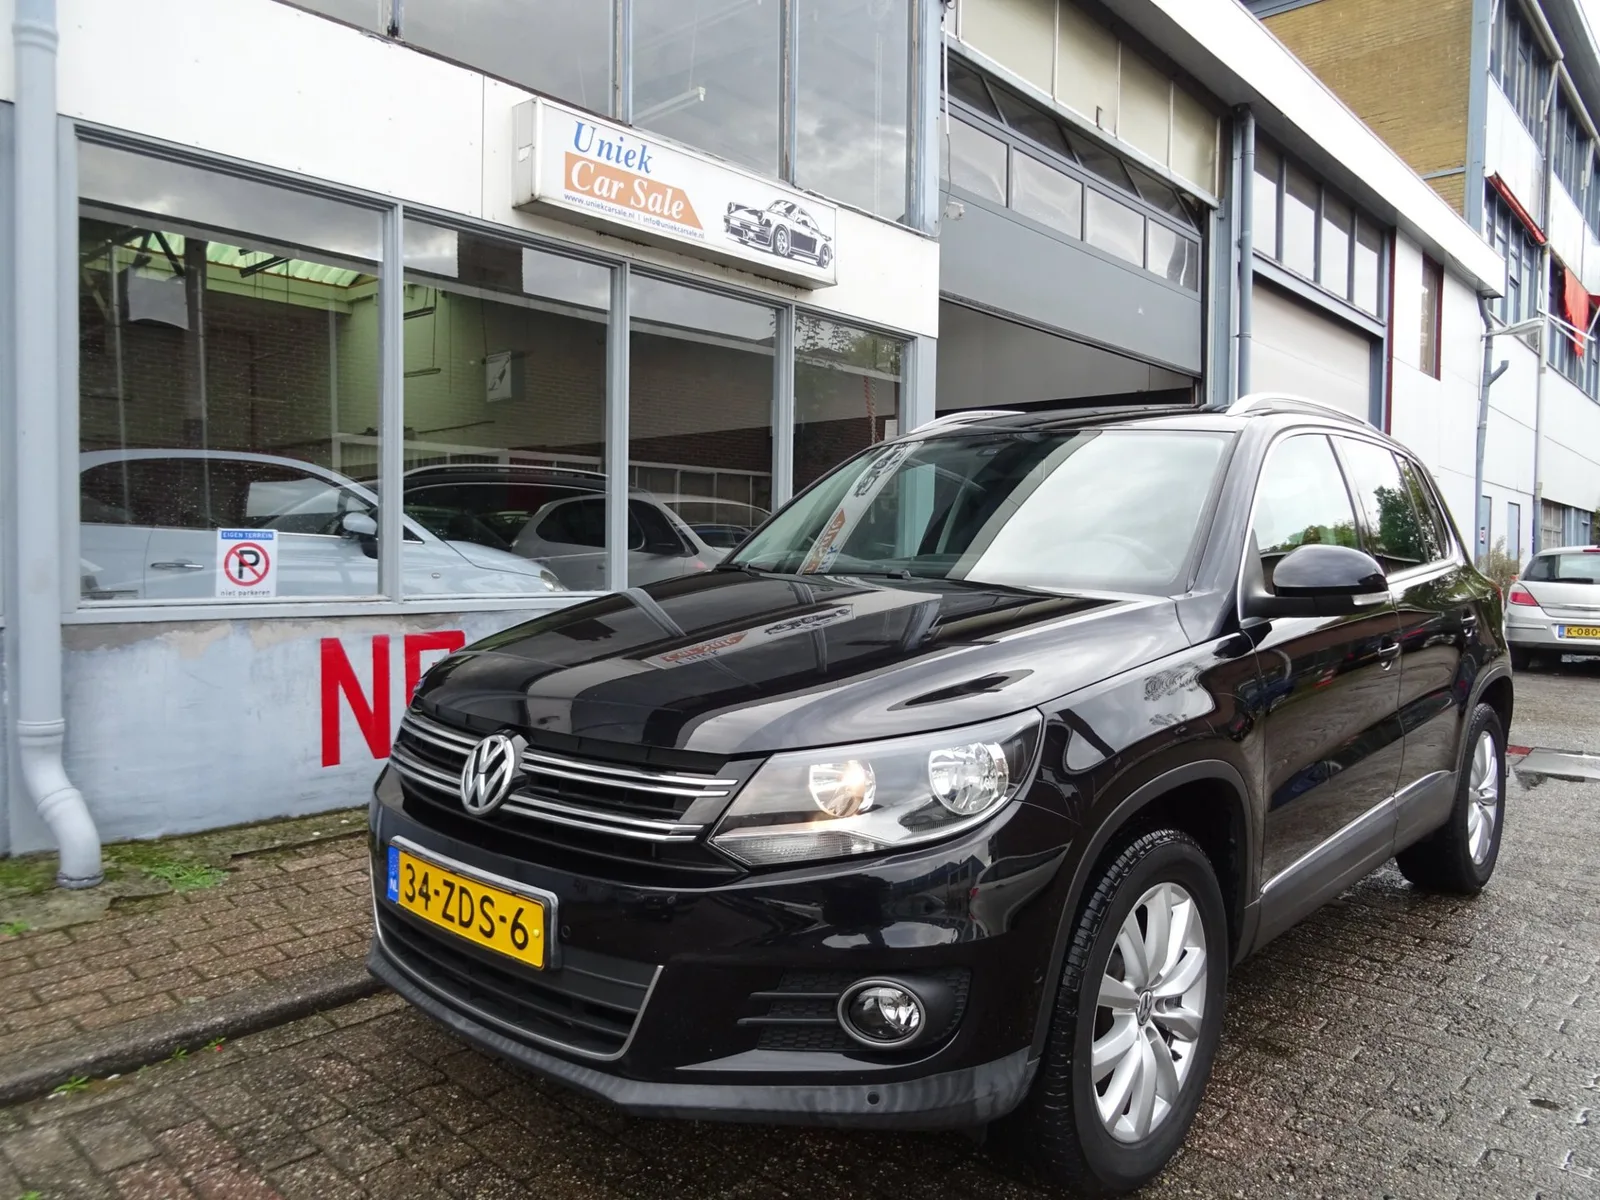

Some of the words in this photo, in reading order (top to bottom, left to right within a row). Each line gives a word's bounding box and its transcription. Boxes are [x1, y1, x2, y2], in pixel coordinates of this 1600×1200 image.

[574, 121, 653, 174] Uniek
[564, 193, 635, 219] www.uniekcarsale.nl
[643, 215, 705, 239] info@uniekcarsale.nl
[571, 160, 624, 200] Car
[630, 178, 685, 219] Sale
[404, 862, 530, 951] 34-ZDS-6
